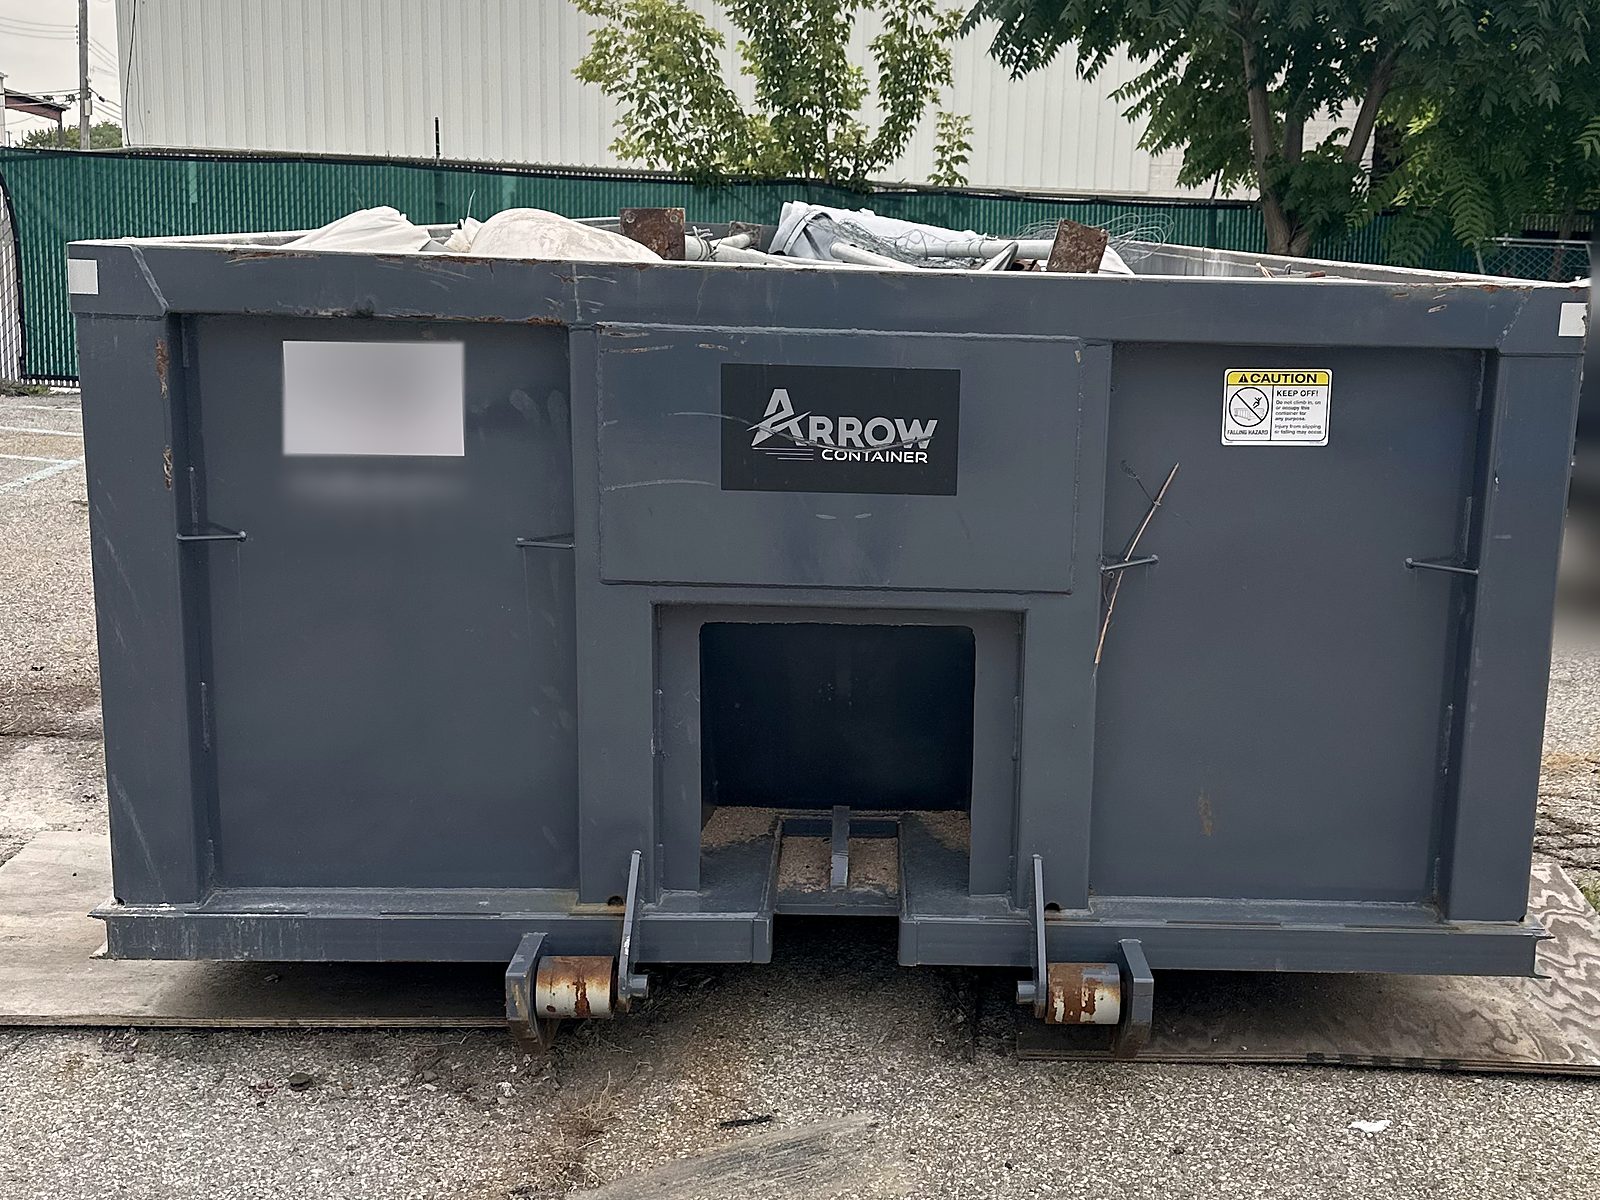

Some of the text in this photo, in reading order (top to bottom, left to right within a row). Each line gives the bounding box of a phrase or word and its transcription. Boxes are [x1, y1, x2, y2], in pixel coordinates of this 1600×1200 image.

[1250, 373, 1317, 384] CAUTION
[1276, 389, 1319, 397] KEEP OFF!
[747, 388, 938, 449] ARROW
[821, 448, 929, 464] CONTAINER
